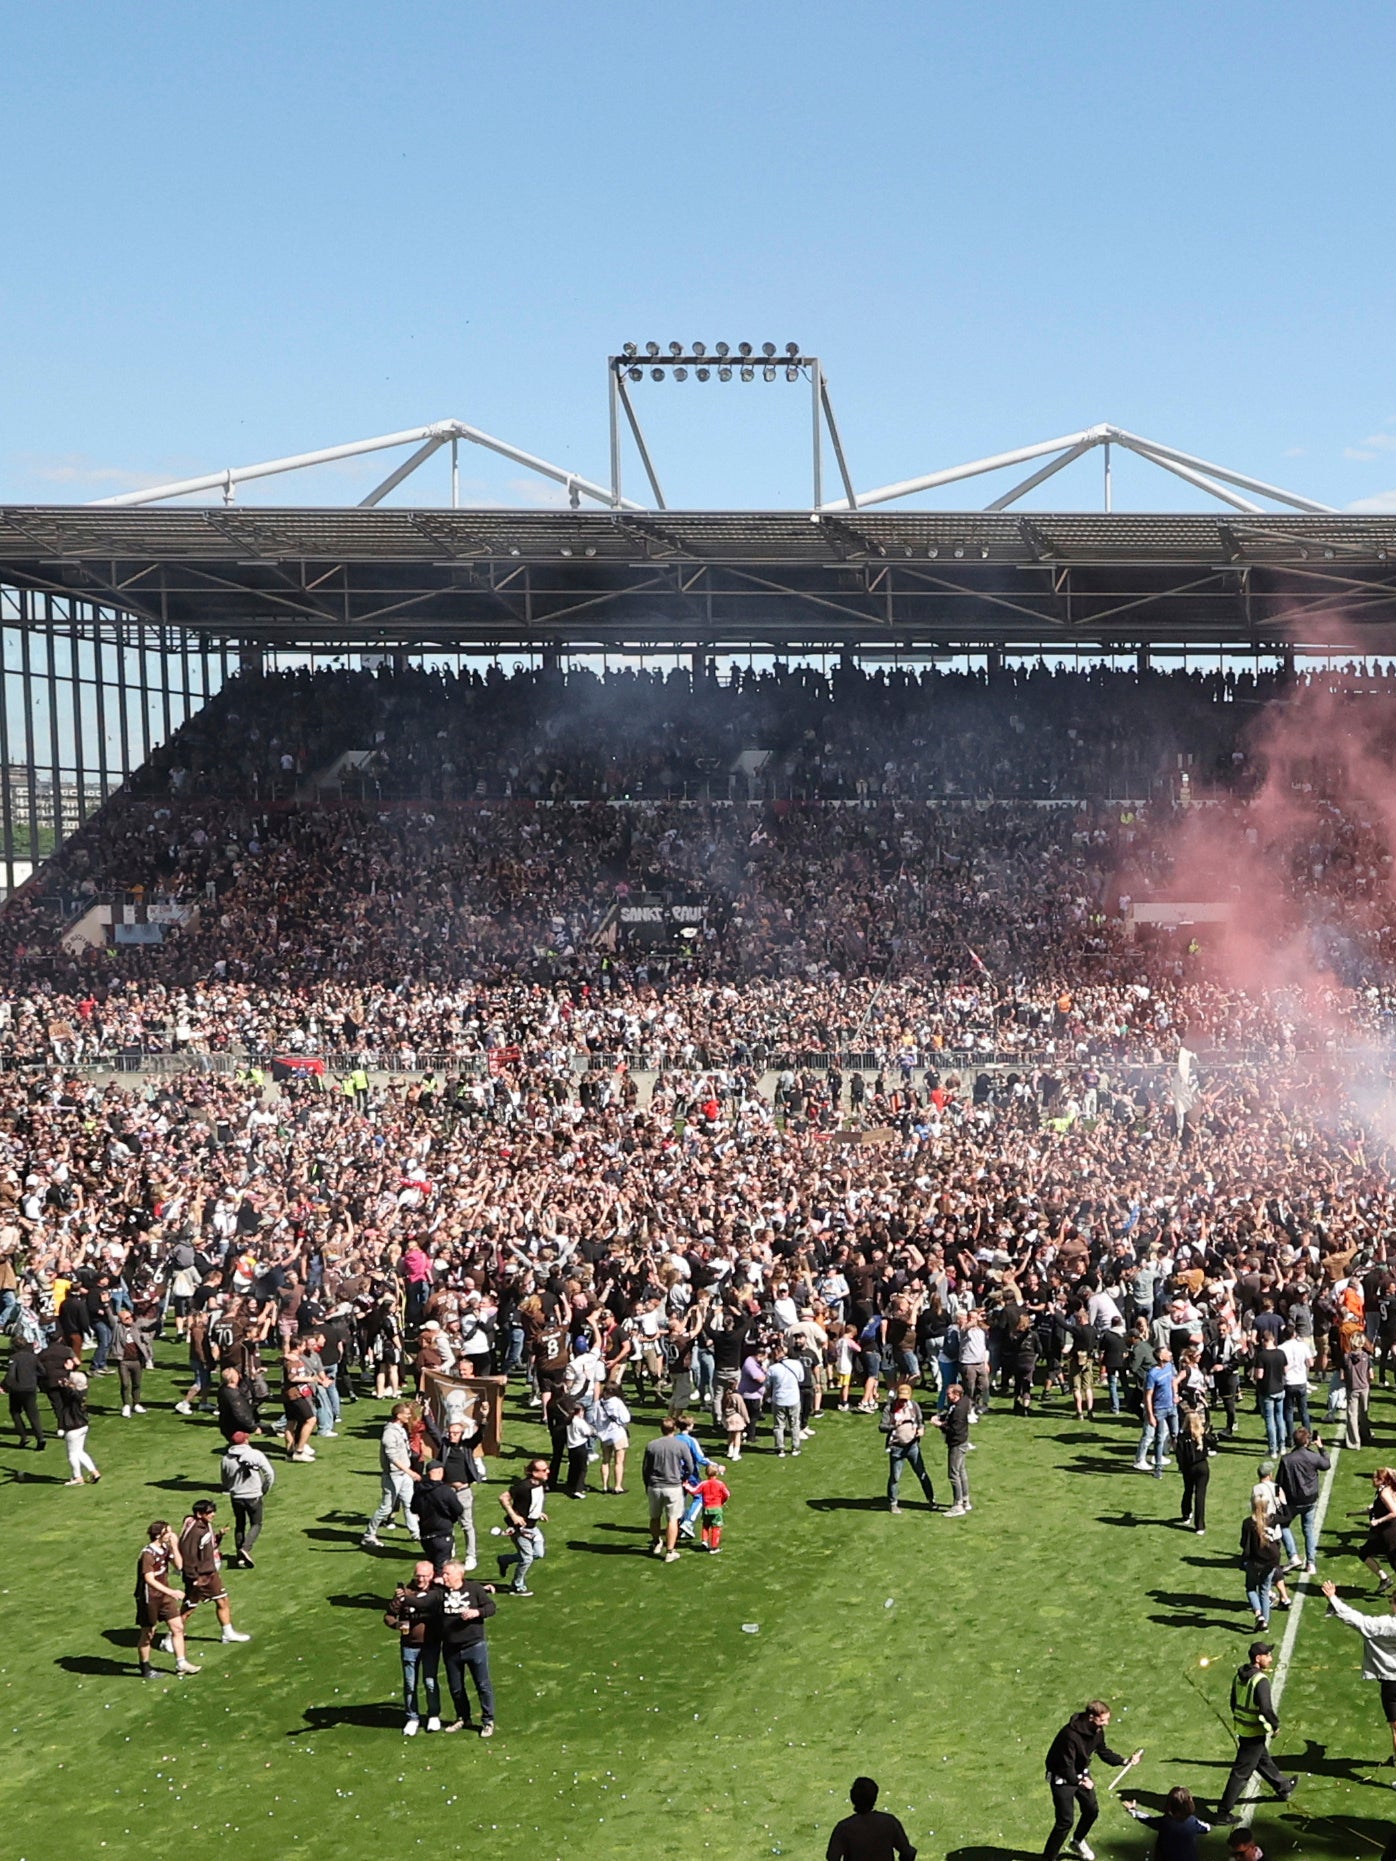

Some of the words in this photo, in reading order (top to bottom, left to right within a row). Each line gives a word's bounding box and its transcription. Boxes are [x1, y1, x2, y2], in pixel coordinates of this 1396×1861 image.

[620, 906, 663, 922] SANKT
[1379, 1304, 1388, 1321] 9
[215, 1328, 234, 1346] 70
[547, 1339, 560, 1355] 8
